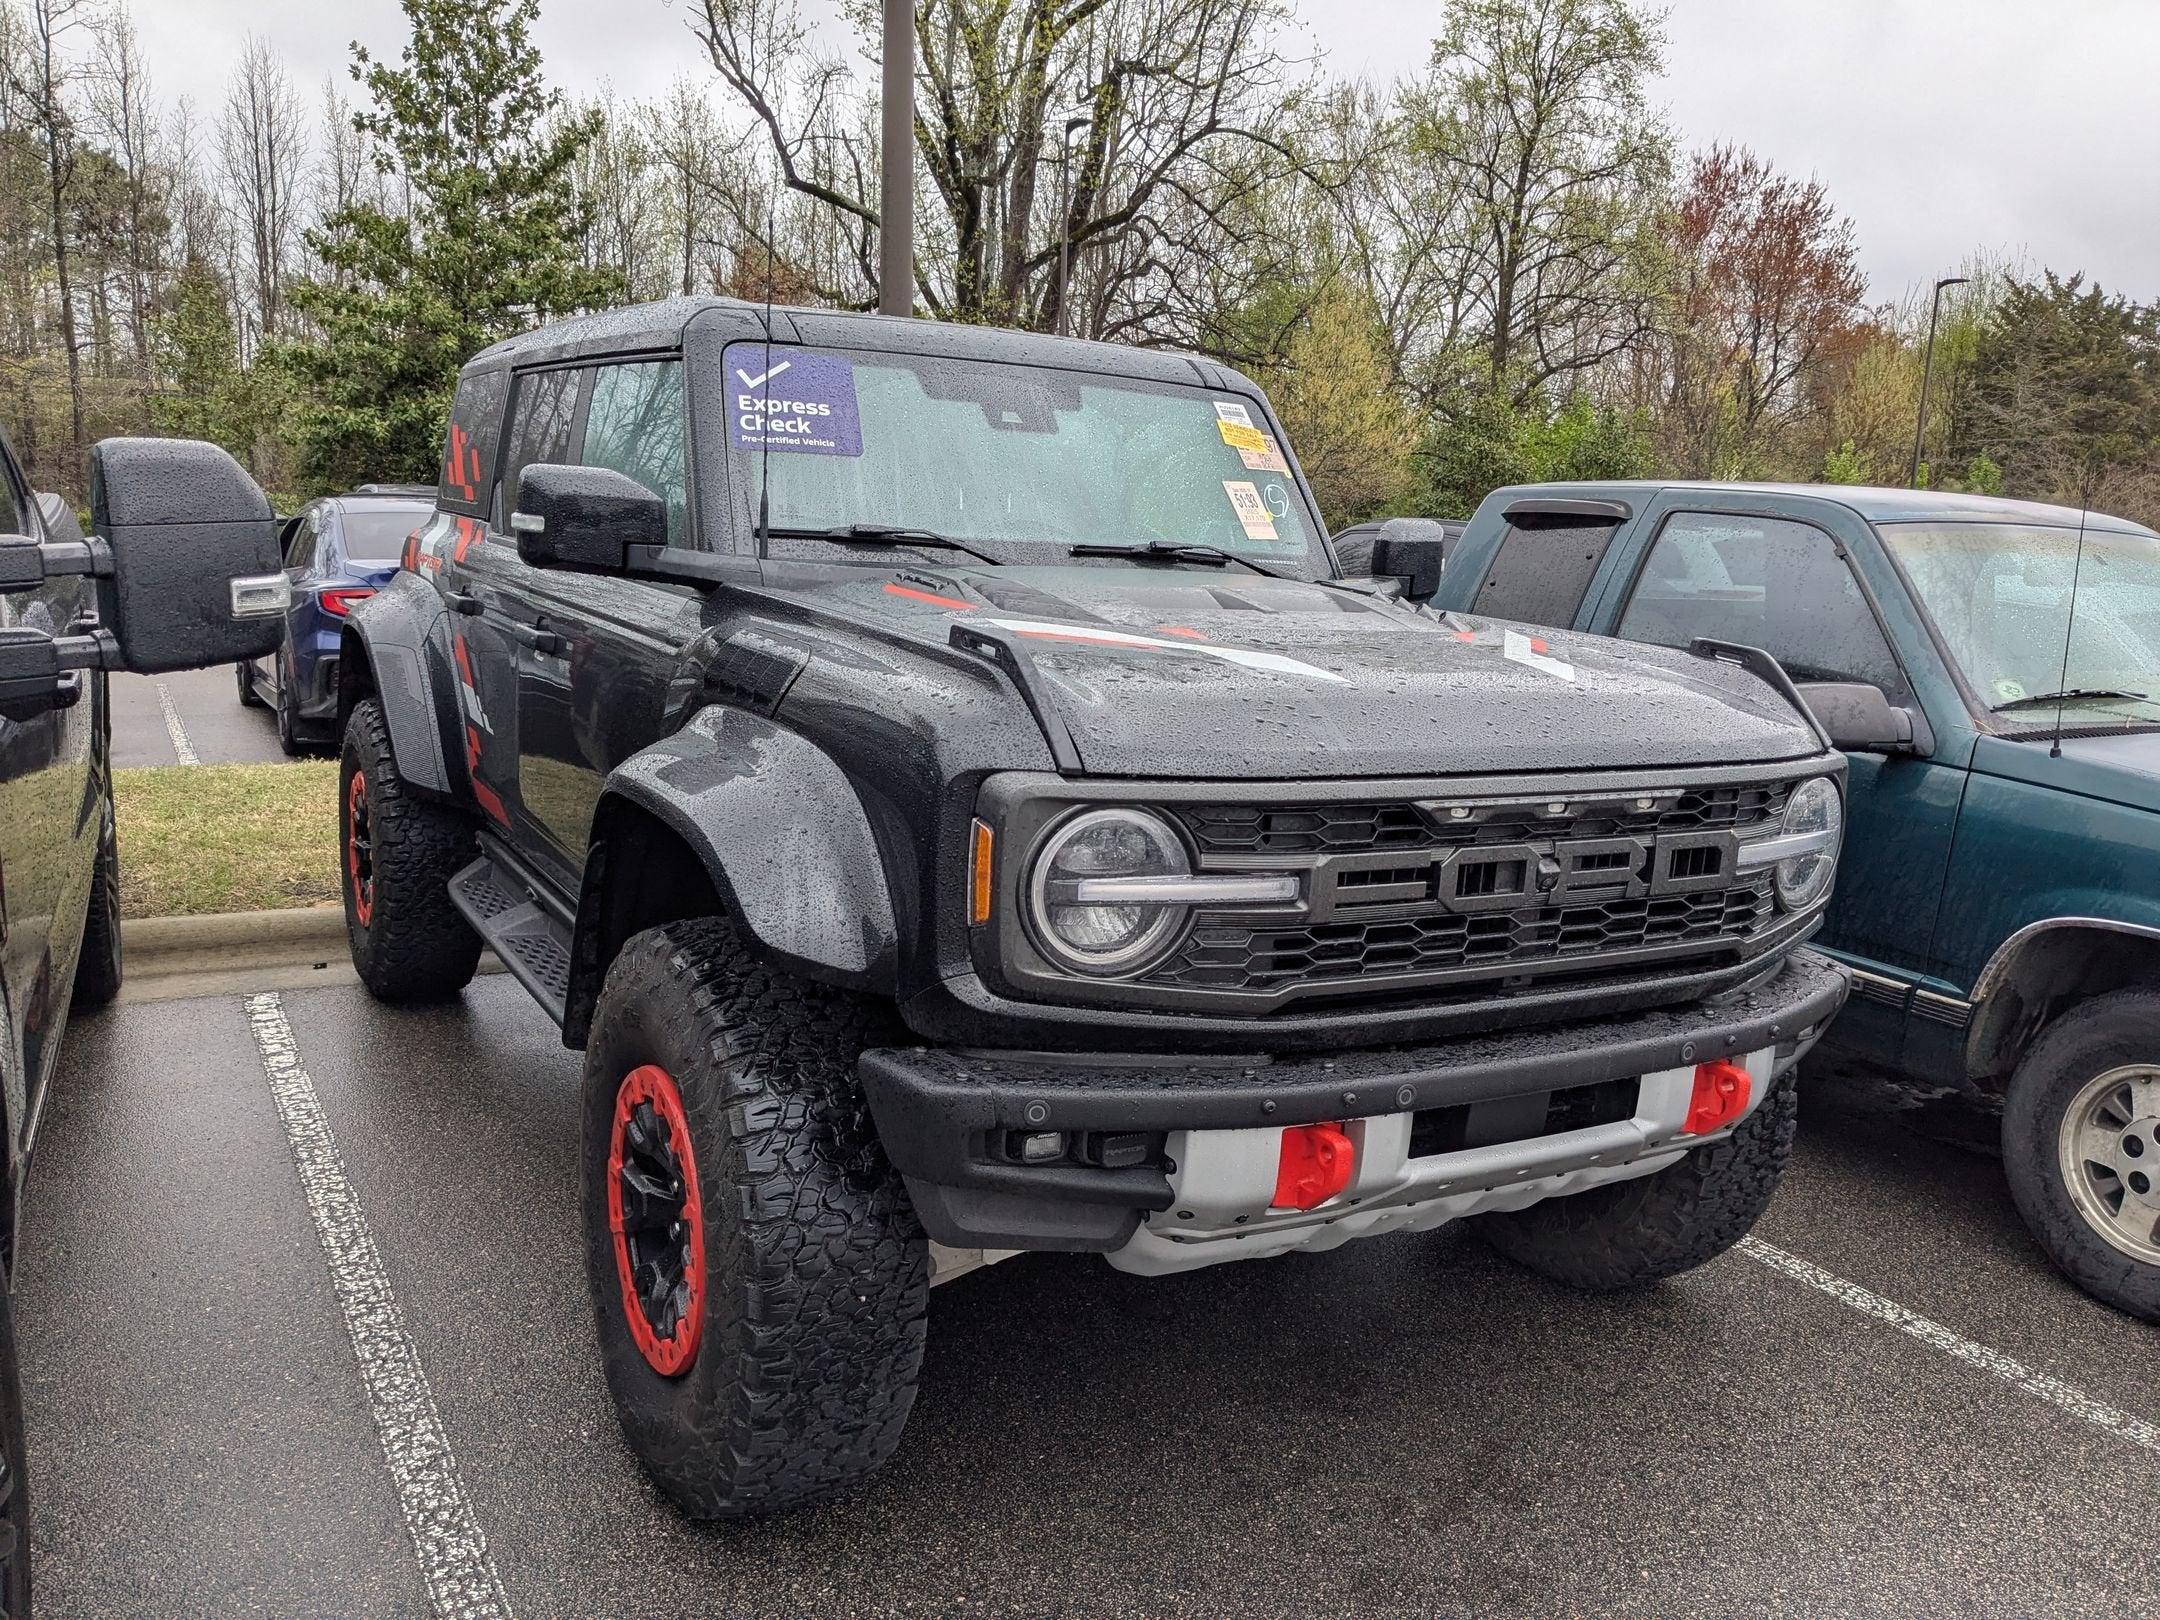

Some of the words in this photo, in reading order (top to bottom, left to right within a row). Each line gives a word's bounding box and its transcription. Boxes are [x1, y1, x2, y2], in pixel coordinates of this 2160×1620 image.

[738, 395, 831, 416] Express
[740, 414, 812, 434] Check
[742, 434, 801, 445] Pre-Certified
[802, 438, 835, 448] Vehicle
[1308, 829, 1739, 925] FORD
